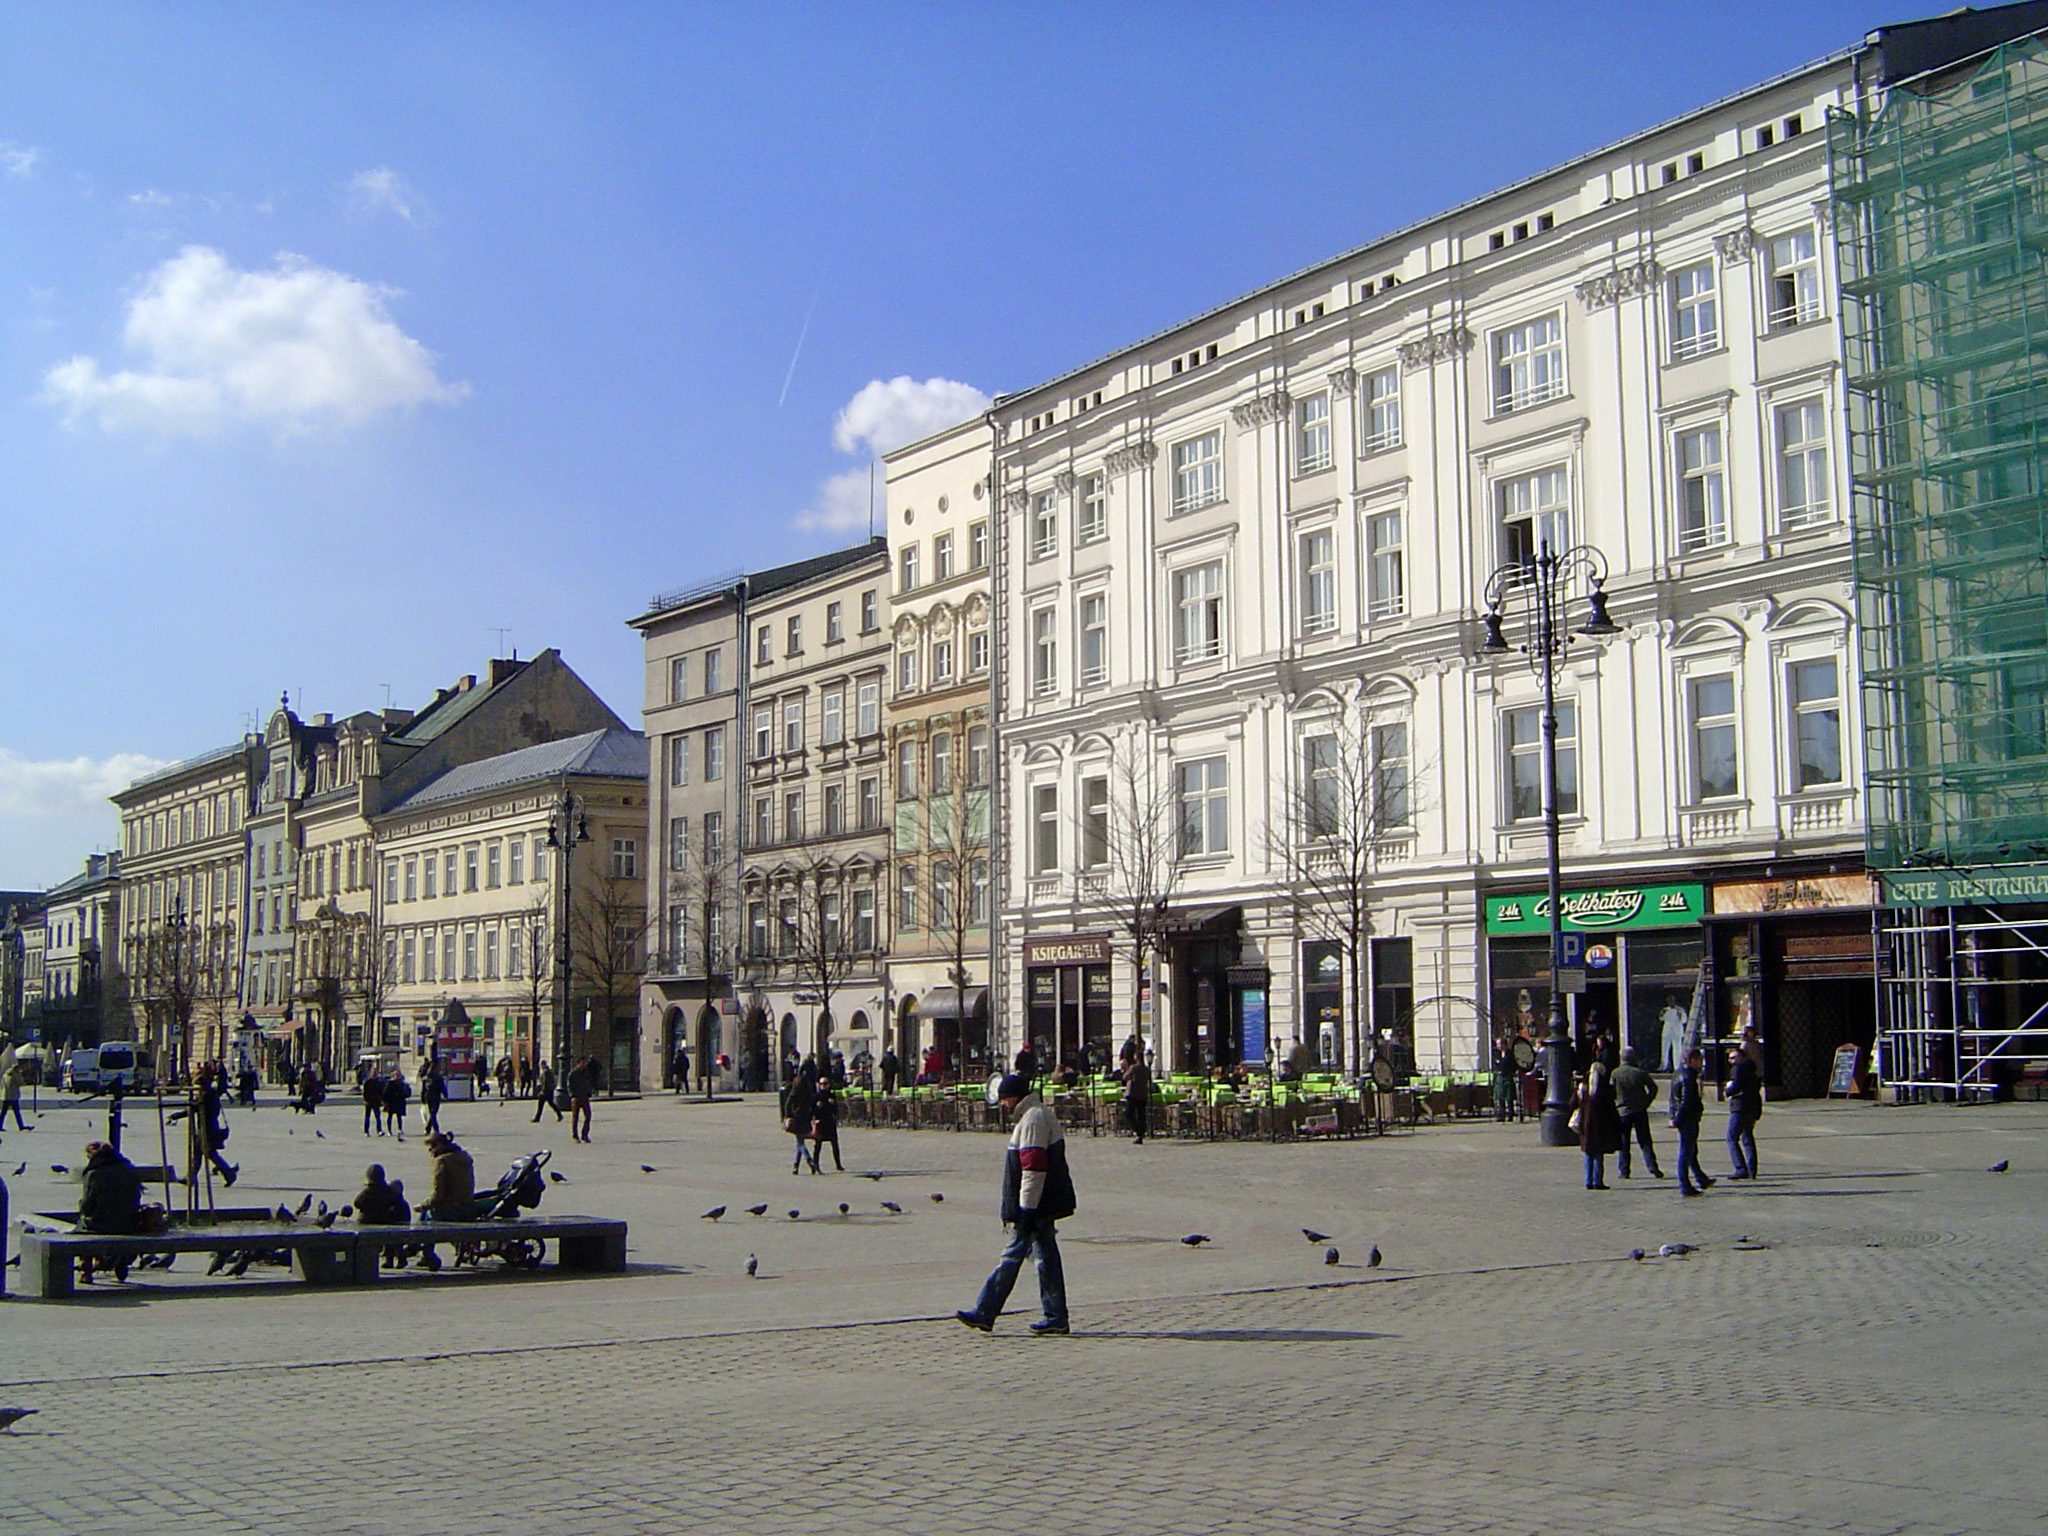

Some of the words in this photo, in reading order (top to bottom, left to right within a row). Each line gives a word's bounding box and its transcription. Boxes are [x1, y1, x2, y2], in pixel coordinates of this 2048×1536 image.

[1660, 891, 1686, 911] 24h
[1892, 882, 1938, 901] CAFE
[1497, 902, 1522, 921] 24h
[1533, 889, 1643, 926] Delikatesy
[1563, 936, 1579, 964] P
[32, 1028, 41, 1038] P
[172, 1024, 181, 1035] P
